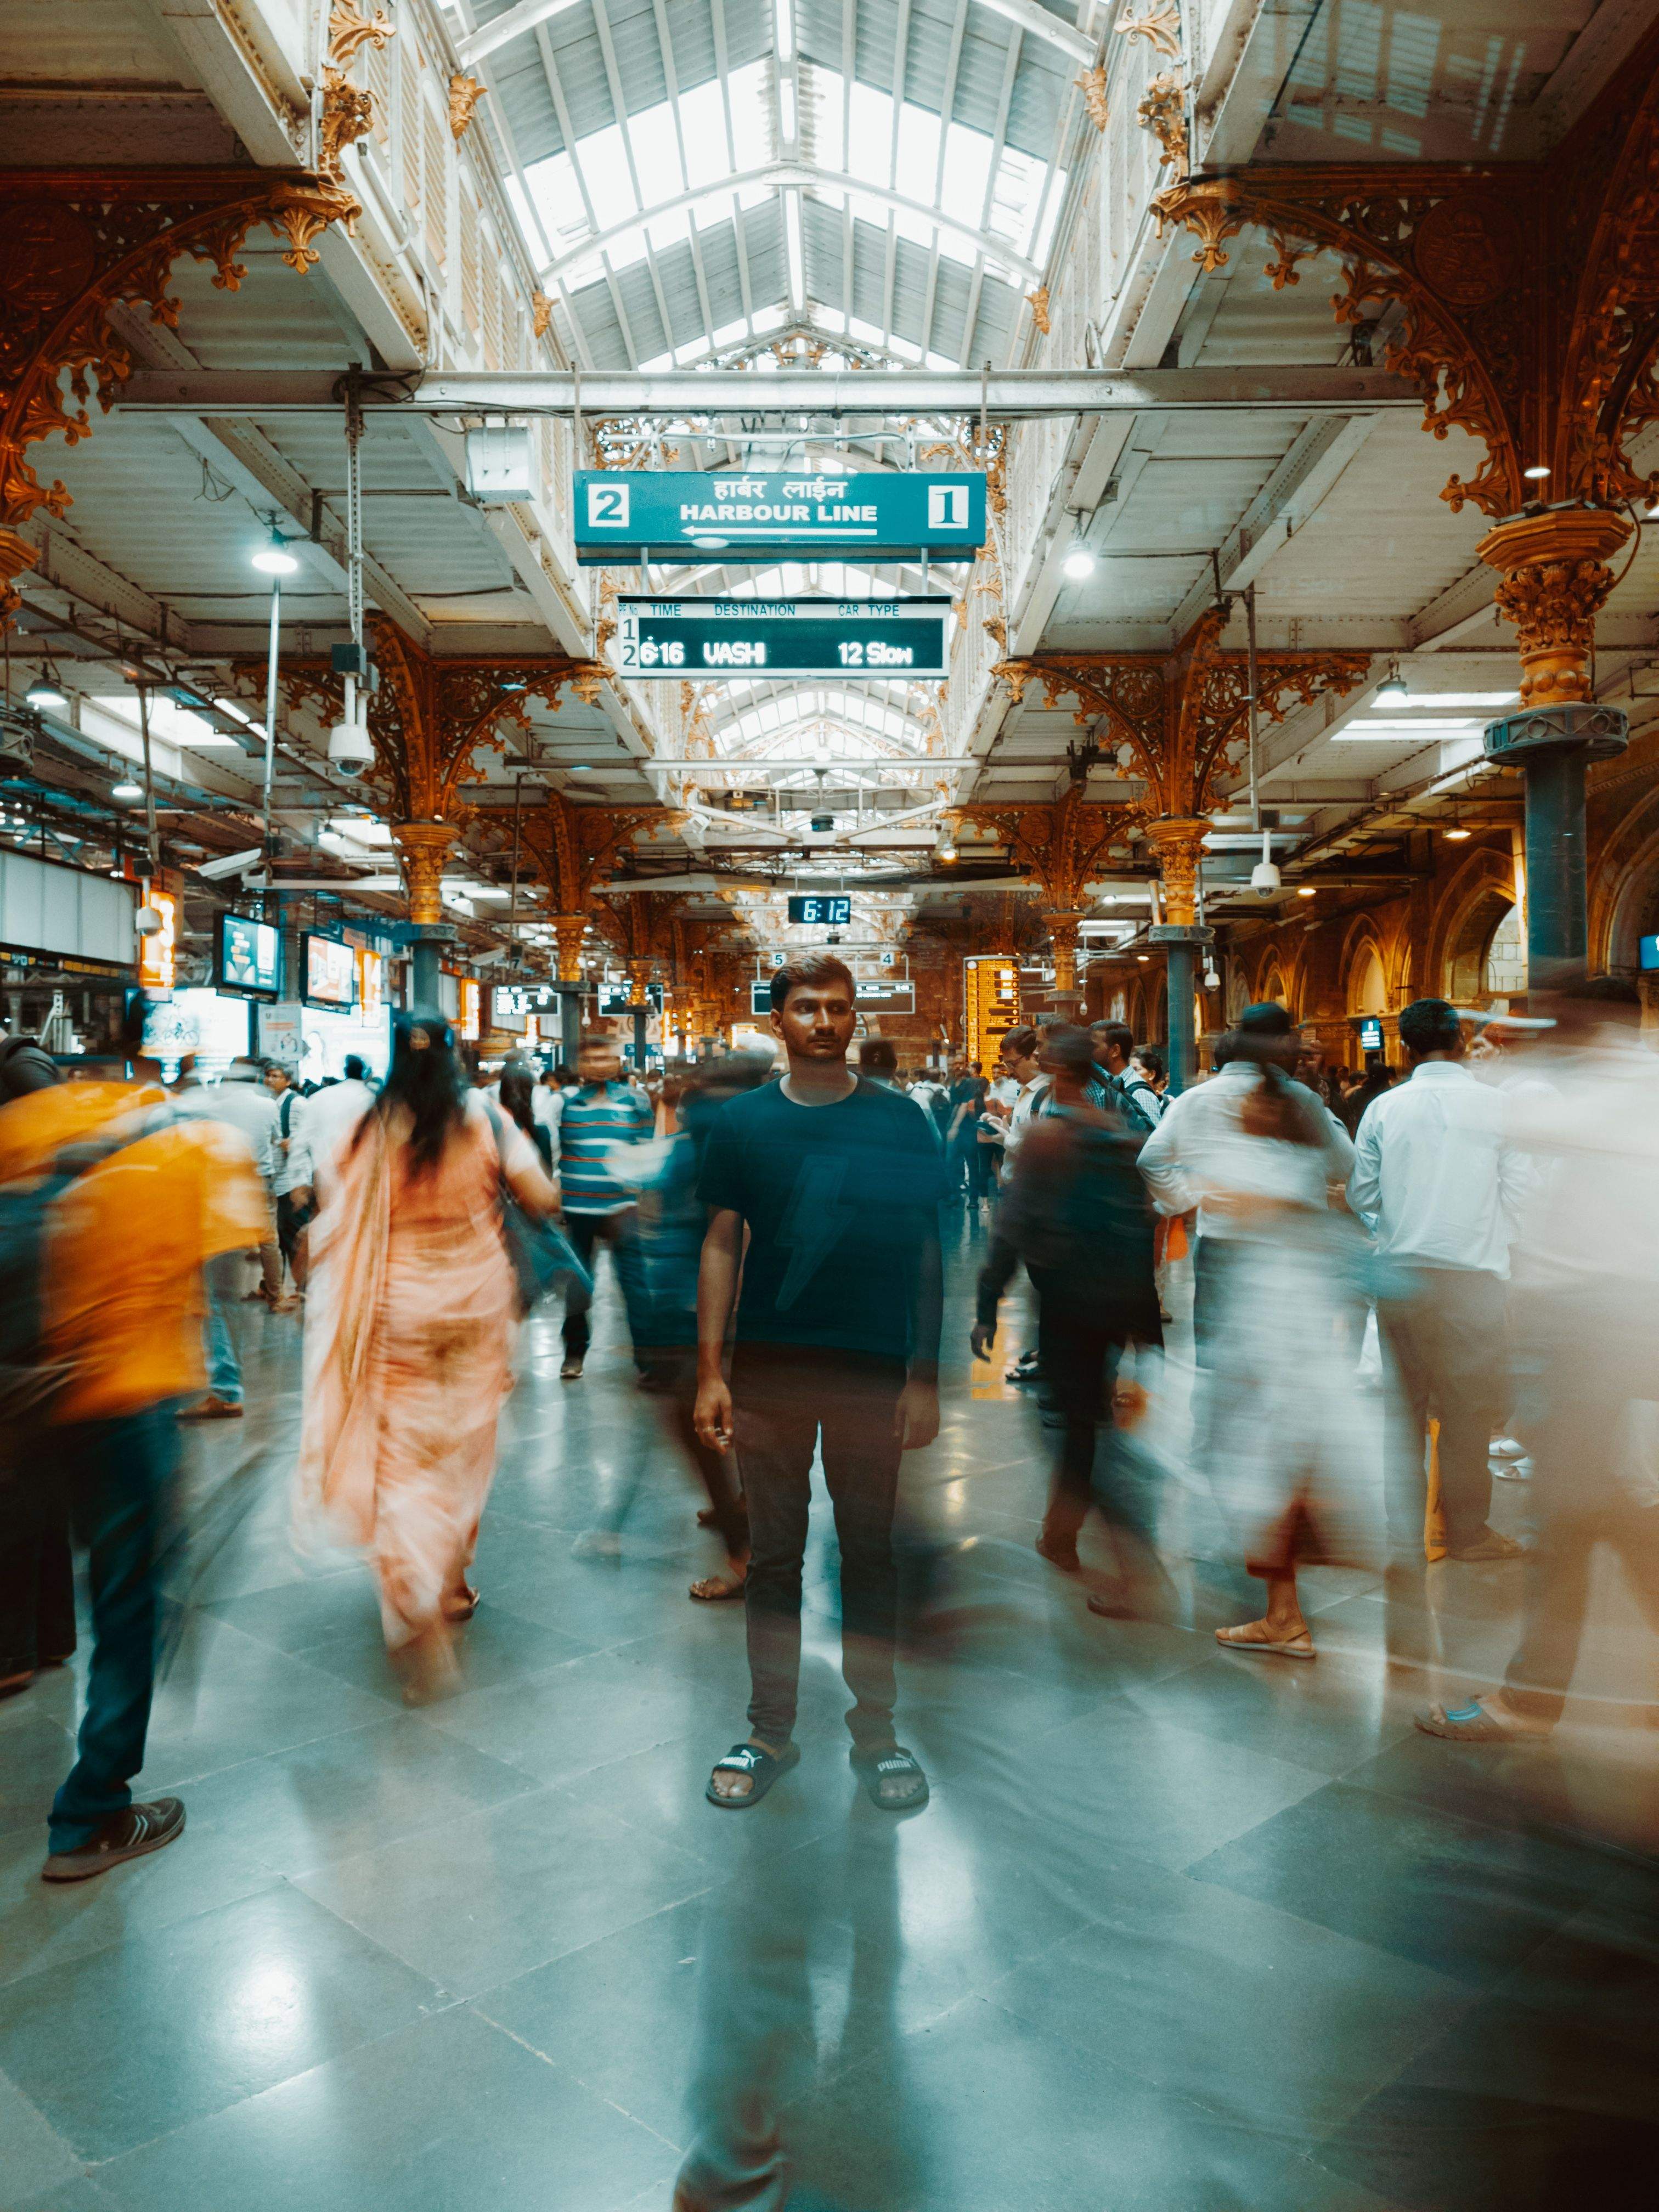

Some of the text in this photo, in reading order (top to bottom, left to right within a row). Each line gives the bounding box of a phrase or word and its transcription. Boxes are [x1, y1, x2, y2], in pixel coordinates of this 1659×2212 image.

[714, 476, 848, 502] हार्बर लाईन
[596, 490, 623, 521] 2
[680, 505, 878, 521] HARBOUR LINE
[935, 491, 963, 523] 1
[650, 604, 681, 616] TIME
[715, 604, 795, 616] DESTINATION
[838, 605, 900, 616] CAR TYPE
[623, 619, 635, 640] 1
[623, 645, 636, 666] 2
[640, 641, 766, 664] 6:16 VASHI
[838, 641, 913, 664] 12 Slow
[804, 900, 848, 921] 6:12
[775, 955, 783, 965] 5
[883, 953, 891, 964] 4
